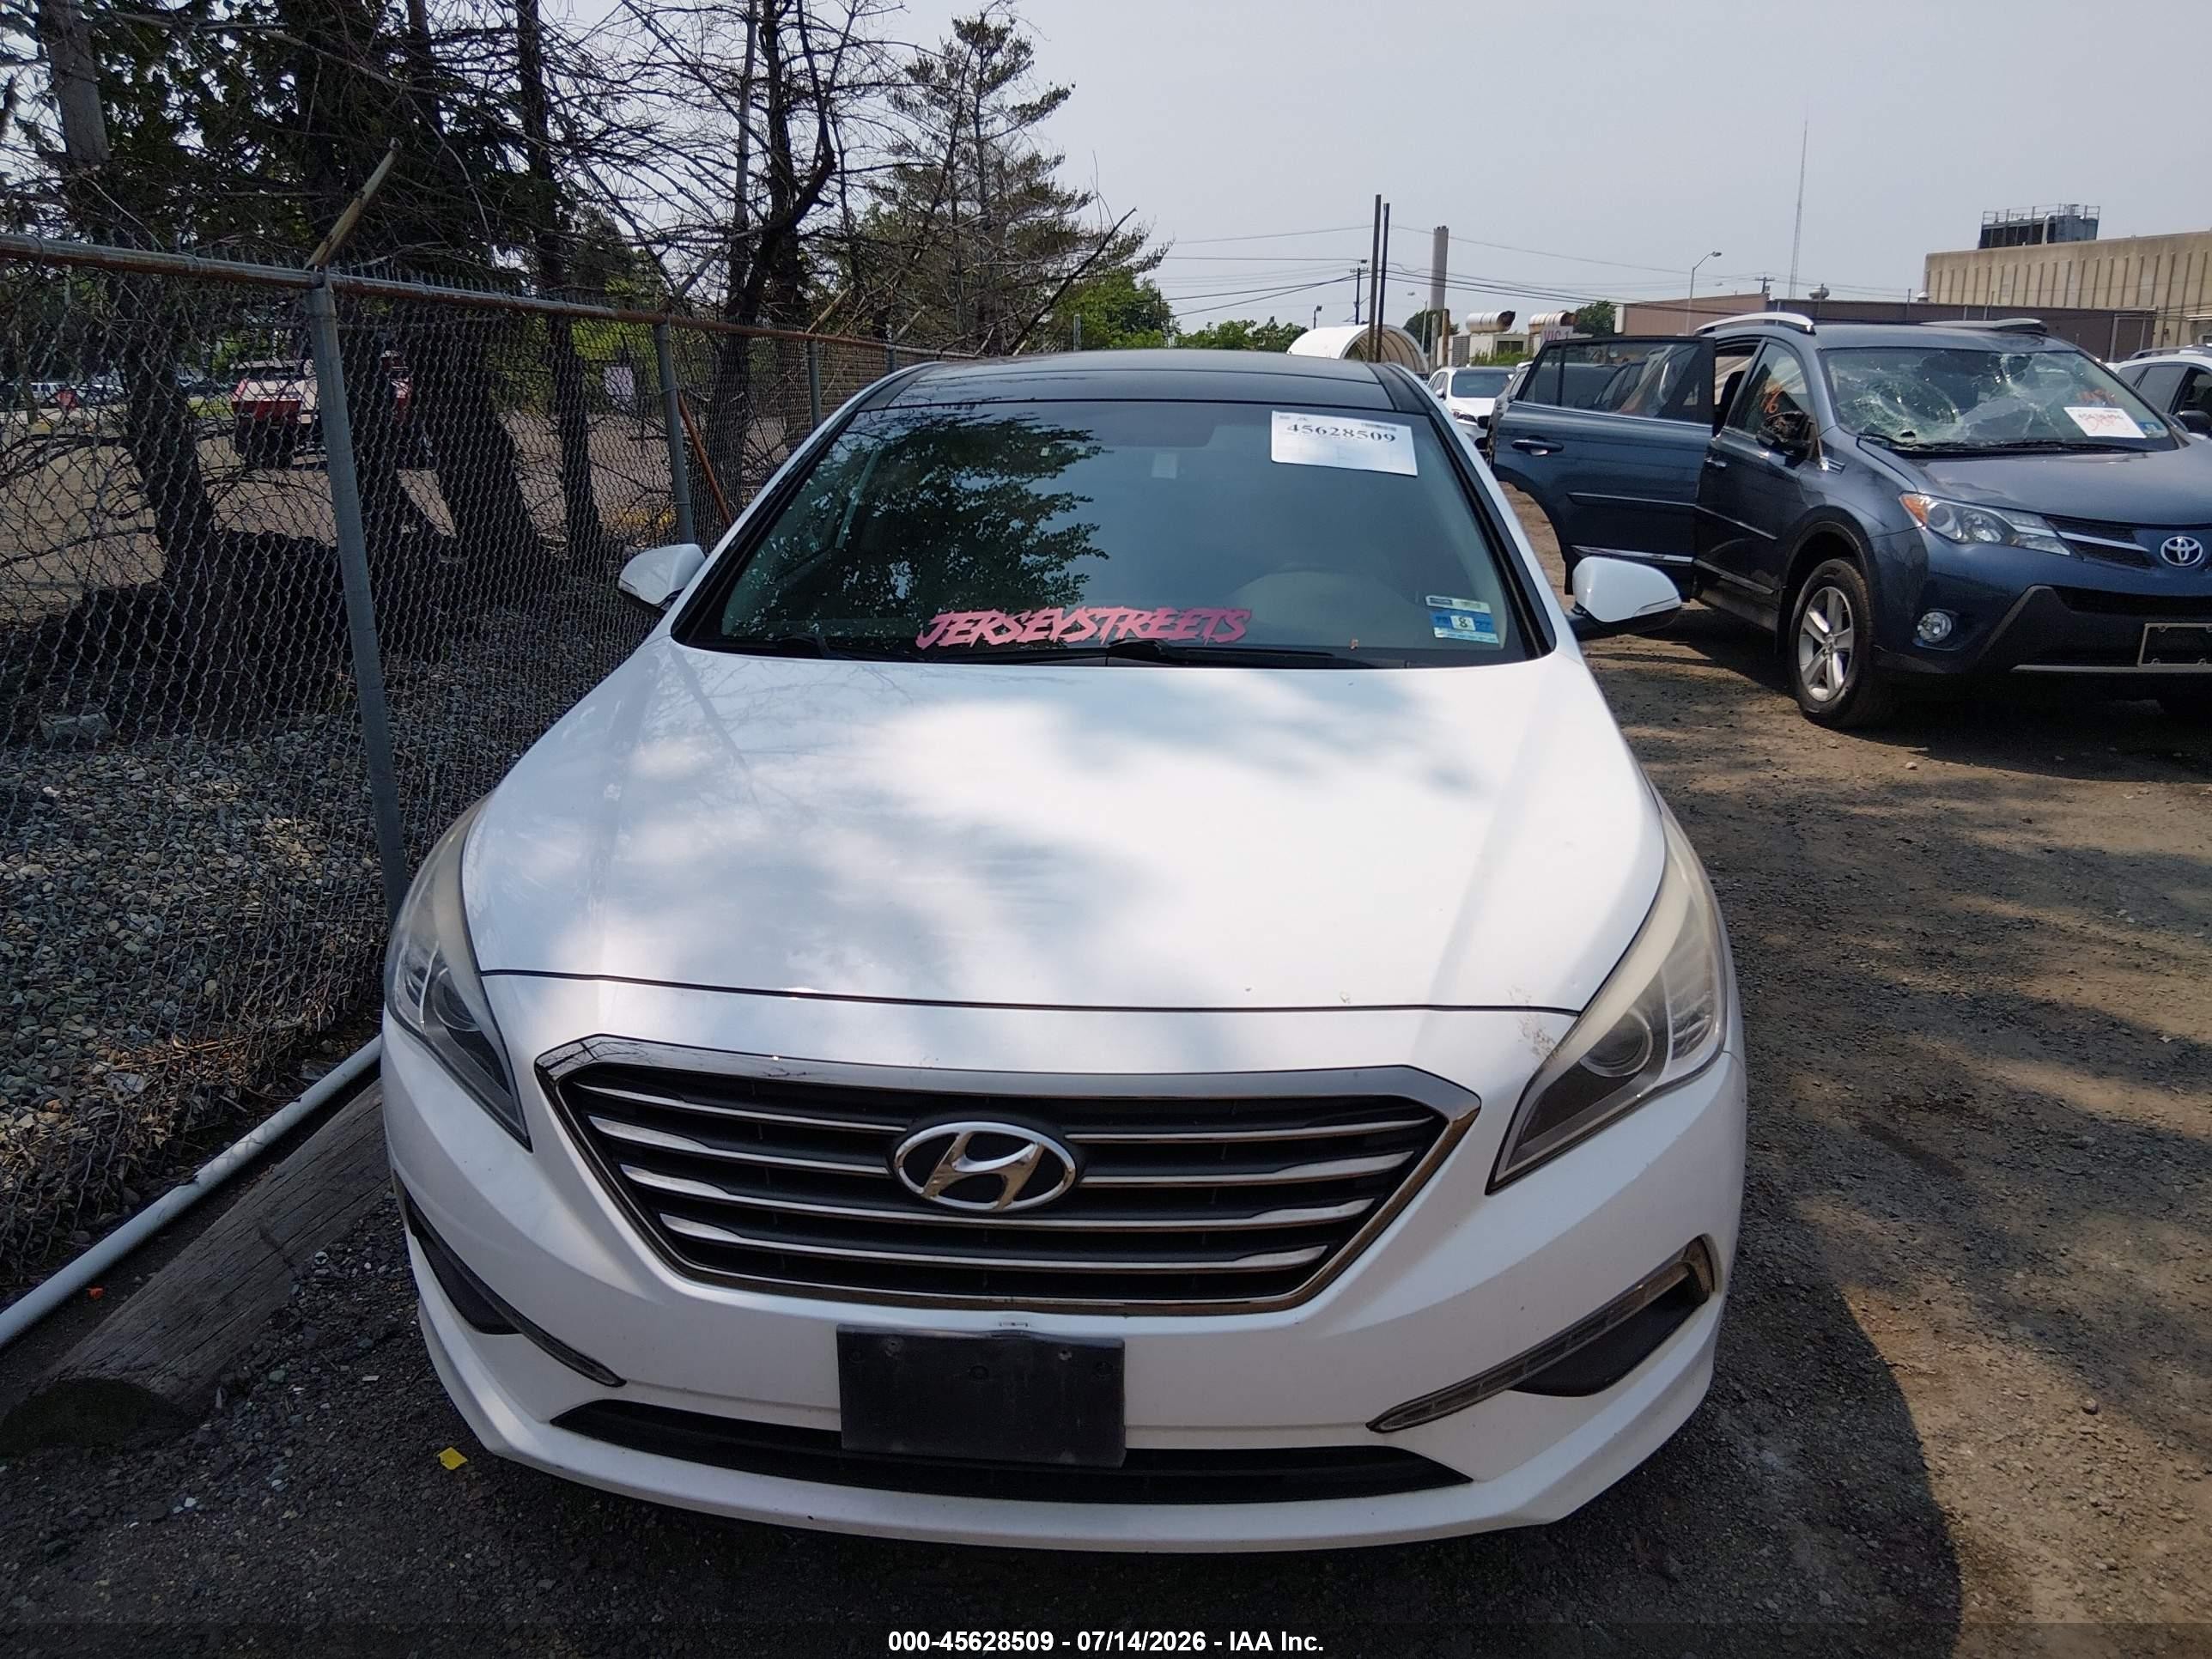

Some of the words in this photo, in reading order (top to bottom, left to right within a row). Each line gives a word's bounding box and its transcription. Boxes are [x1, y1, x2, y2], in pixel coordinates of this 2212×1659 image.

[1287, 423, 1396, 443] 45628509
[915, 605, 1252, 649] JERSEYSTREETS
[1458, 617, 1468, 629] 8
